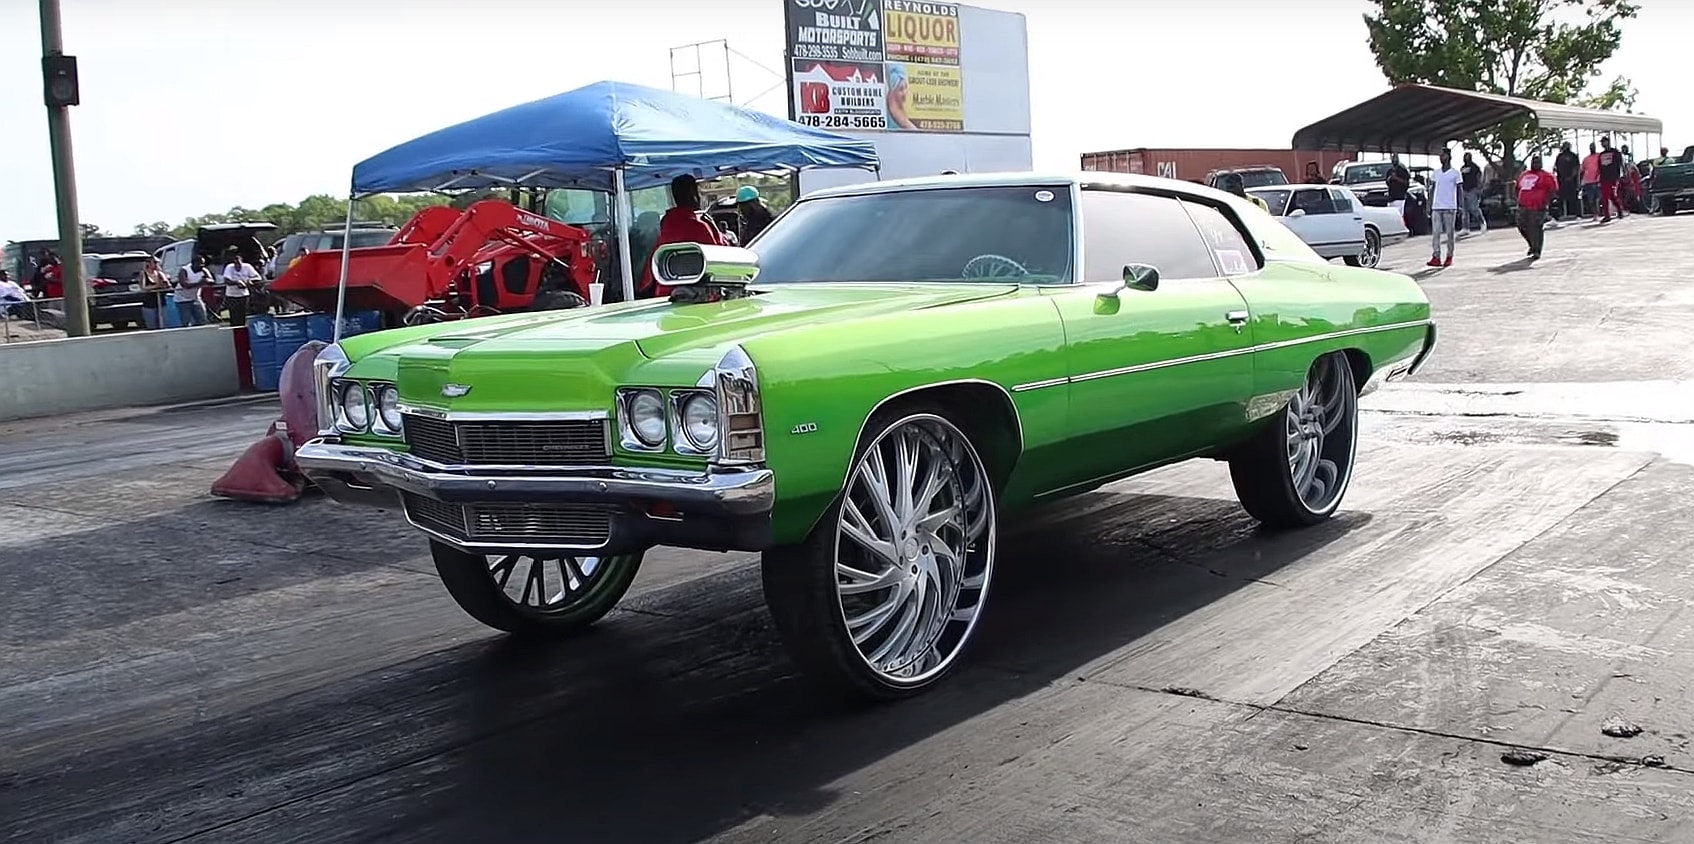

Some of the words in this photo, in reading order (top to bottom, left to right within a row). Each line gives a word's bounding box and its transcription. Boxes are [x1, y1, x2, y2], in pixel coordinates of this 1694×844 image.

[885, 0, 957, 16] REYNOLDS
[816, 12, 861, 29] BUILT
[886, 13, 955, 43] LIQUOR
[799, 26, 876, 46] MOTORSPORTS
[801, 82, 829, 113] KB
[832, 87, 861, 96] CUSTOM
[863, 88, 882, 97] HOME
[841, 97, 874, 106] BUILDERS
[799, 116, 885, 128] 478-284-5665
[791, 422, 818, 434] 400
